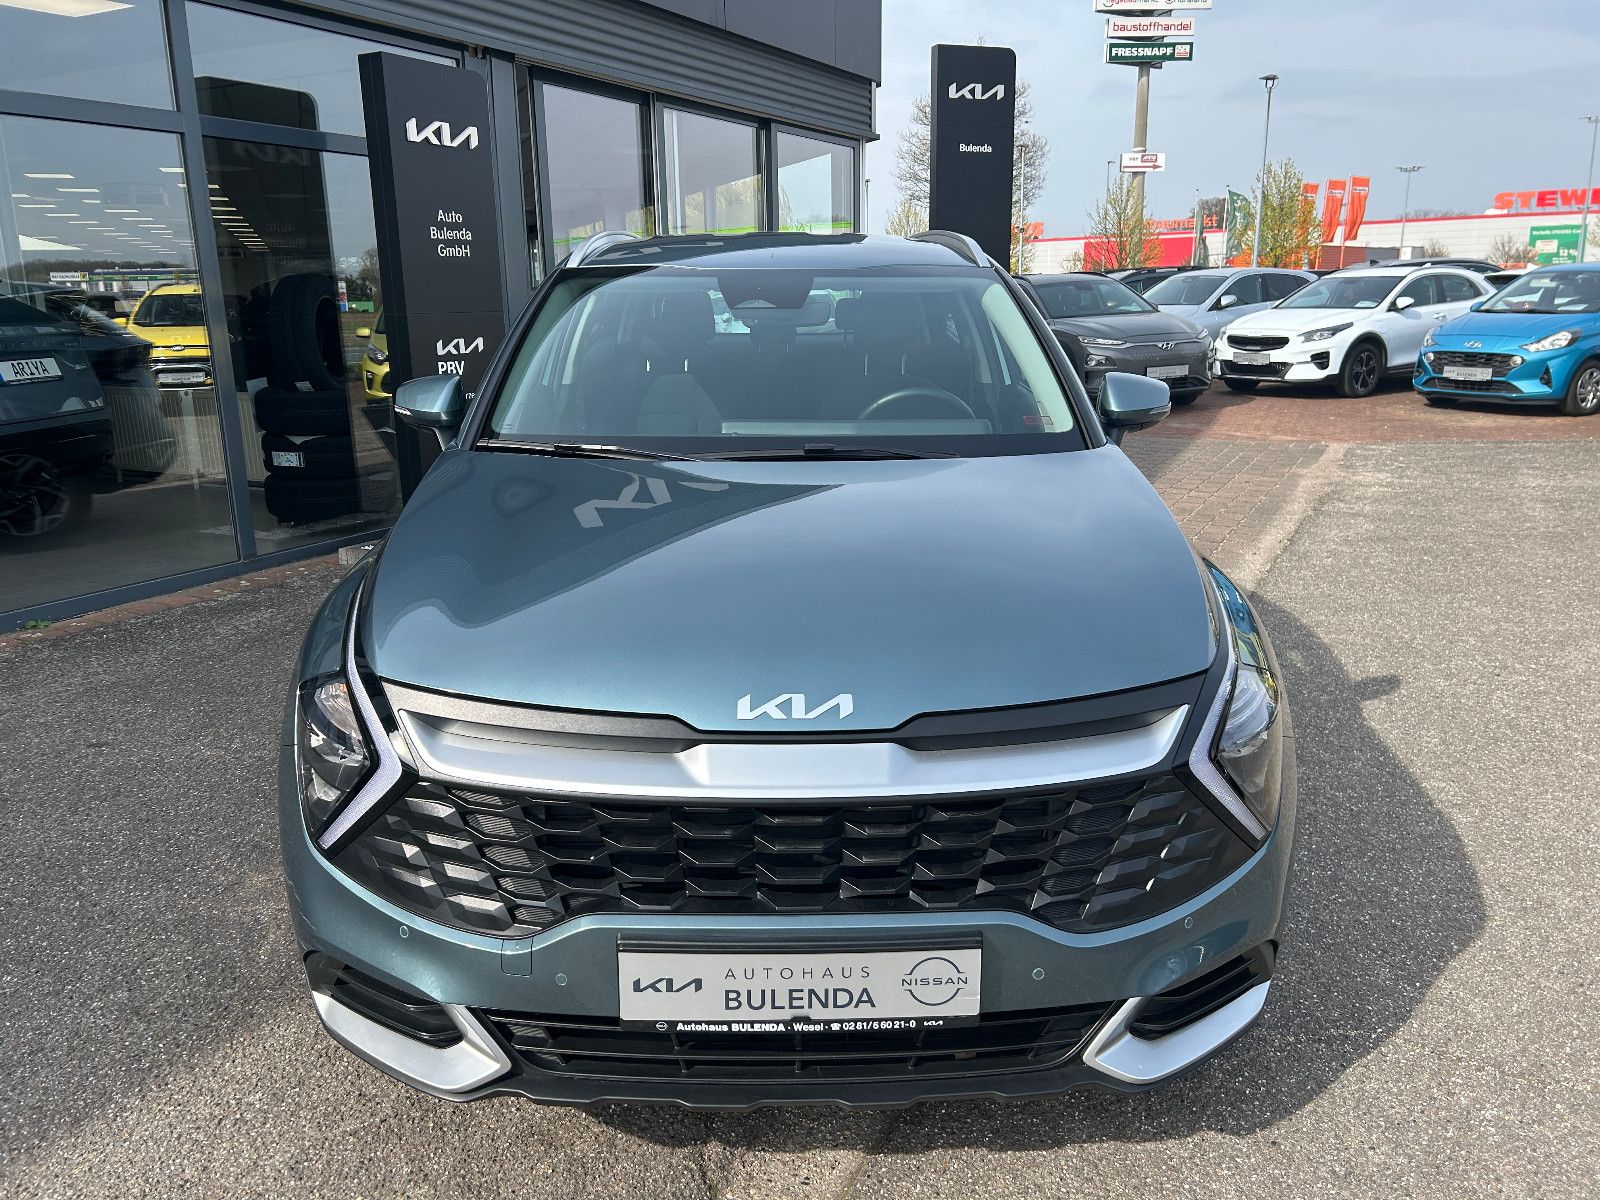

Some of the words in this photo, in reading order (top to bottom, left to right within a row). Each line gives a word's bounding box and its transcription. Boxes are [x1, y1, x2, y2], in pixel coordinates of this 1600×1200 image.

[1112, 21, 1192, 32] baustoffhandel
[1111, 47, 1174, 57] FRESSNAPF
[949, 82, 1005, 101] KIA
[406, 117, 479, 150] KIA
[959, 143, 992, 153] Bulenda
[437, 210, 463, 223] Auto
[430, 227, 472, 241] Bulenda
[437, 244, 471, 257] GmbH
[436, 336, 484, 355] KIA
[11, 360, 49, 378] ARIYA
[737, 693, 854, 720] KIA
[724, 966, 871, 980] AUTOHAUS
[632, 977, 703, 993] KIA
[724, 987, 877, 1011] BULENDA
[901, 976, 968, 987] NISSAN
[676, 1022, 729, 1032] Autohaus
[731, 1023, 786, 1032] BULENDA
[792, 1022, 824, 1032] Wesel
